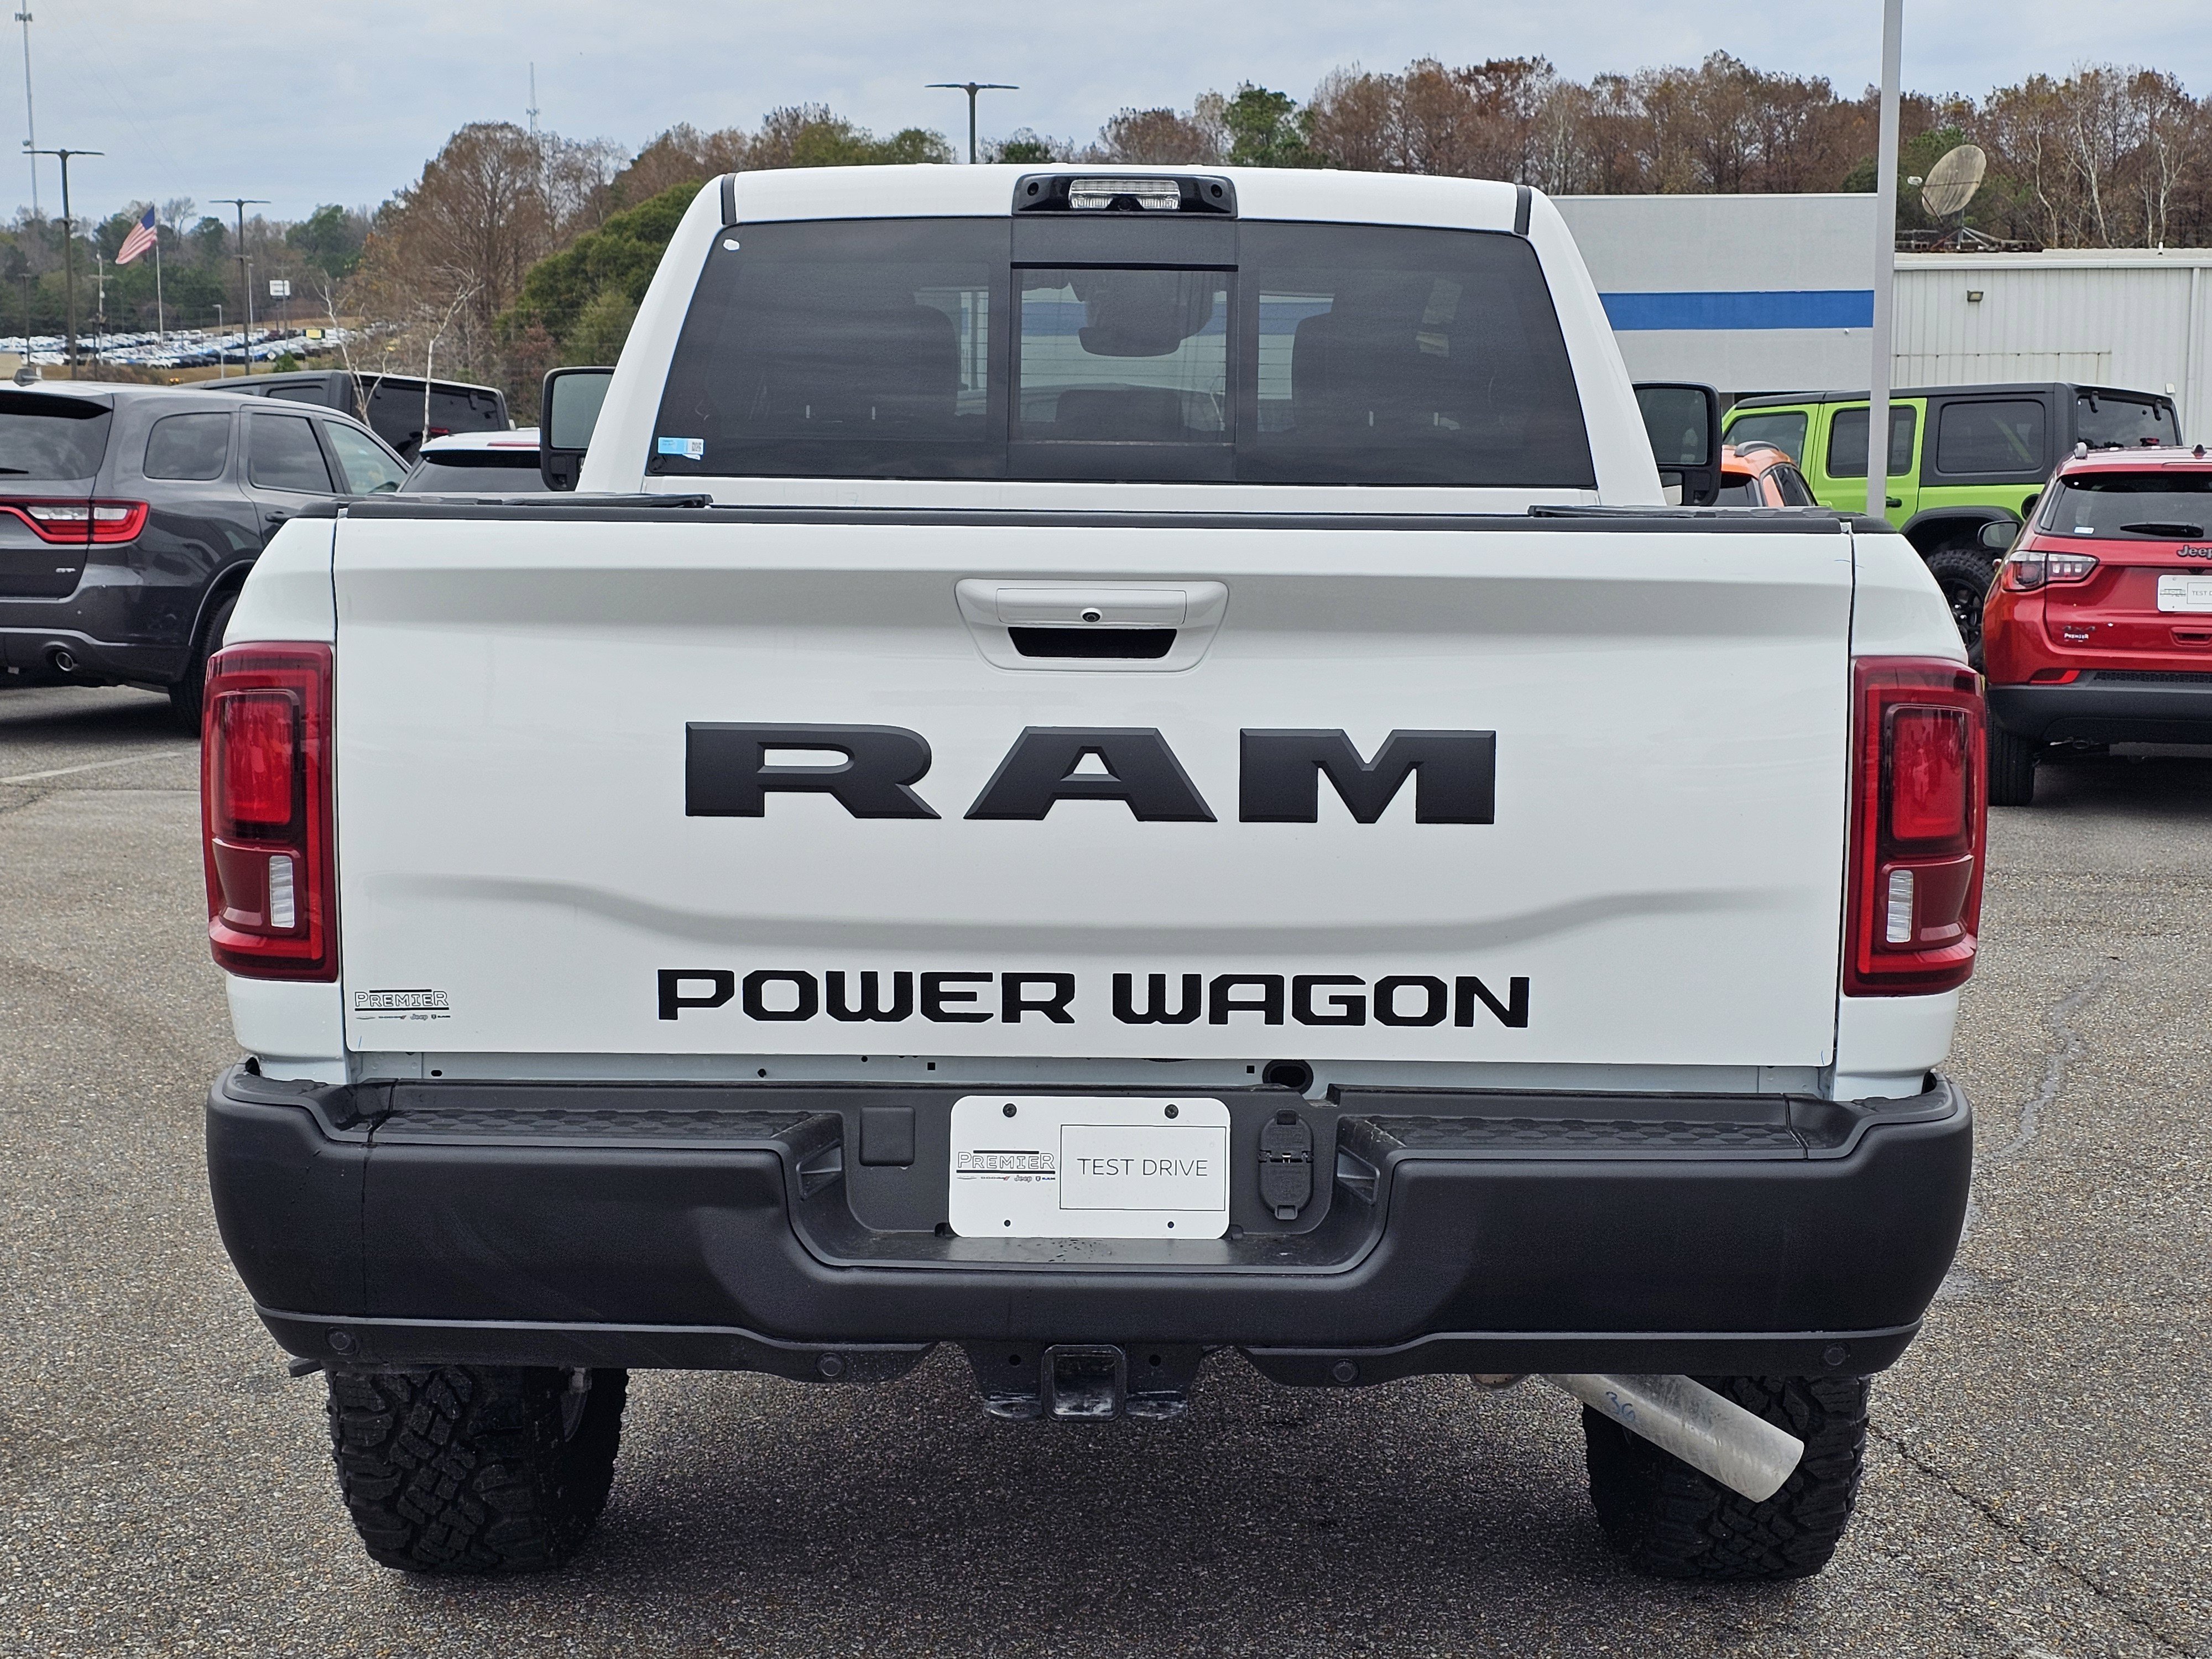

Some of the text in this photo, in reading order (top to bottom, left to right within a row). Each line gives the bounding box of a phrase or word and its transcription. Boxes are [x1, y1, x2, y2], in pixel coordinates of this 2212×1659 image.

[686, 722, 1496, 824] RAM
[354, 990, 449, 1008] PREMIER
[658, 969, 1530, 1028] POWER WAGON
[957, 1151, 1056, 1169] PREMIER
[1077, 1158, 1208, 1176] TEST DRIVE
[1014, 1175, 1032, 1183] Jeep
